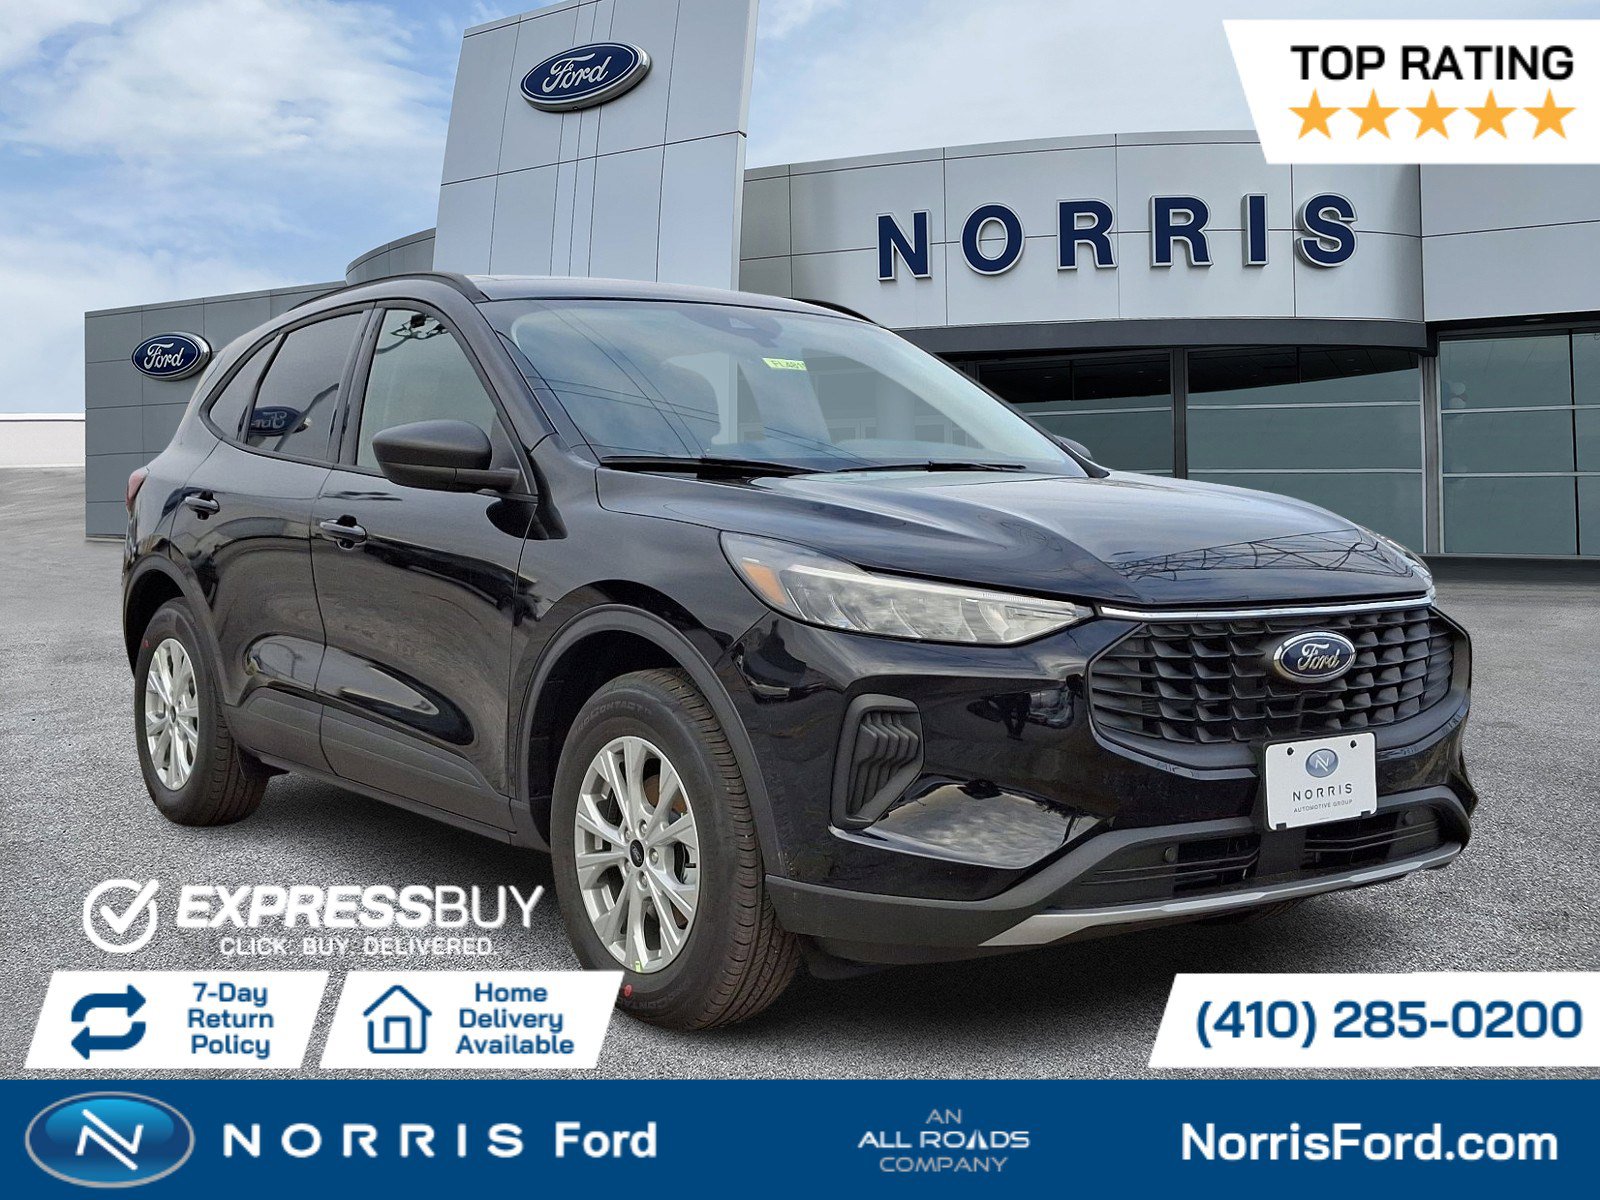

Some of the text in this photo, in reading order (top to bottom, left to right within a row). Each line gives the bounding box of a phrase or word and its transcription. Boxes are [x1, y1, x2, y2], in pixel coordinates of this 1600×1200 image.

[541, 52, 612, 93] Ford
[876, 192, 1359, 282] NORRIS
[143, 342, 185, 370] Ford
[1297, 643, 1341, 671] Ford
[1292, 783, 1353, 802] NORRIS
[1293, 799, 1353, 813] AUTOMOTIVE GROUP
